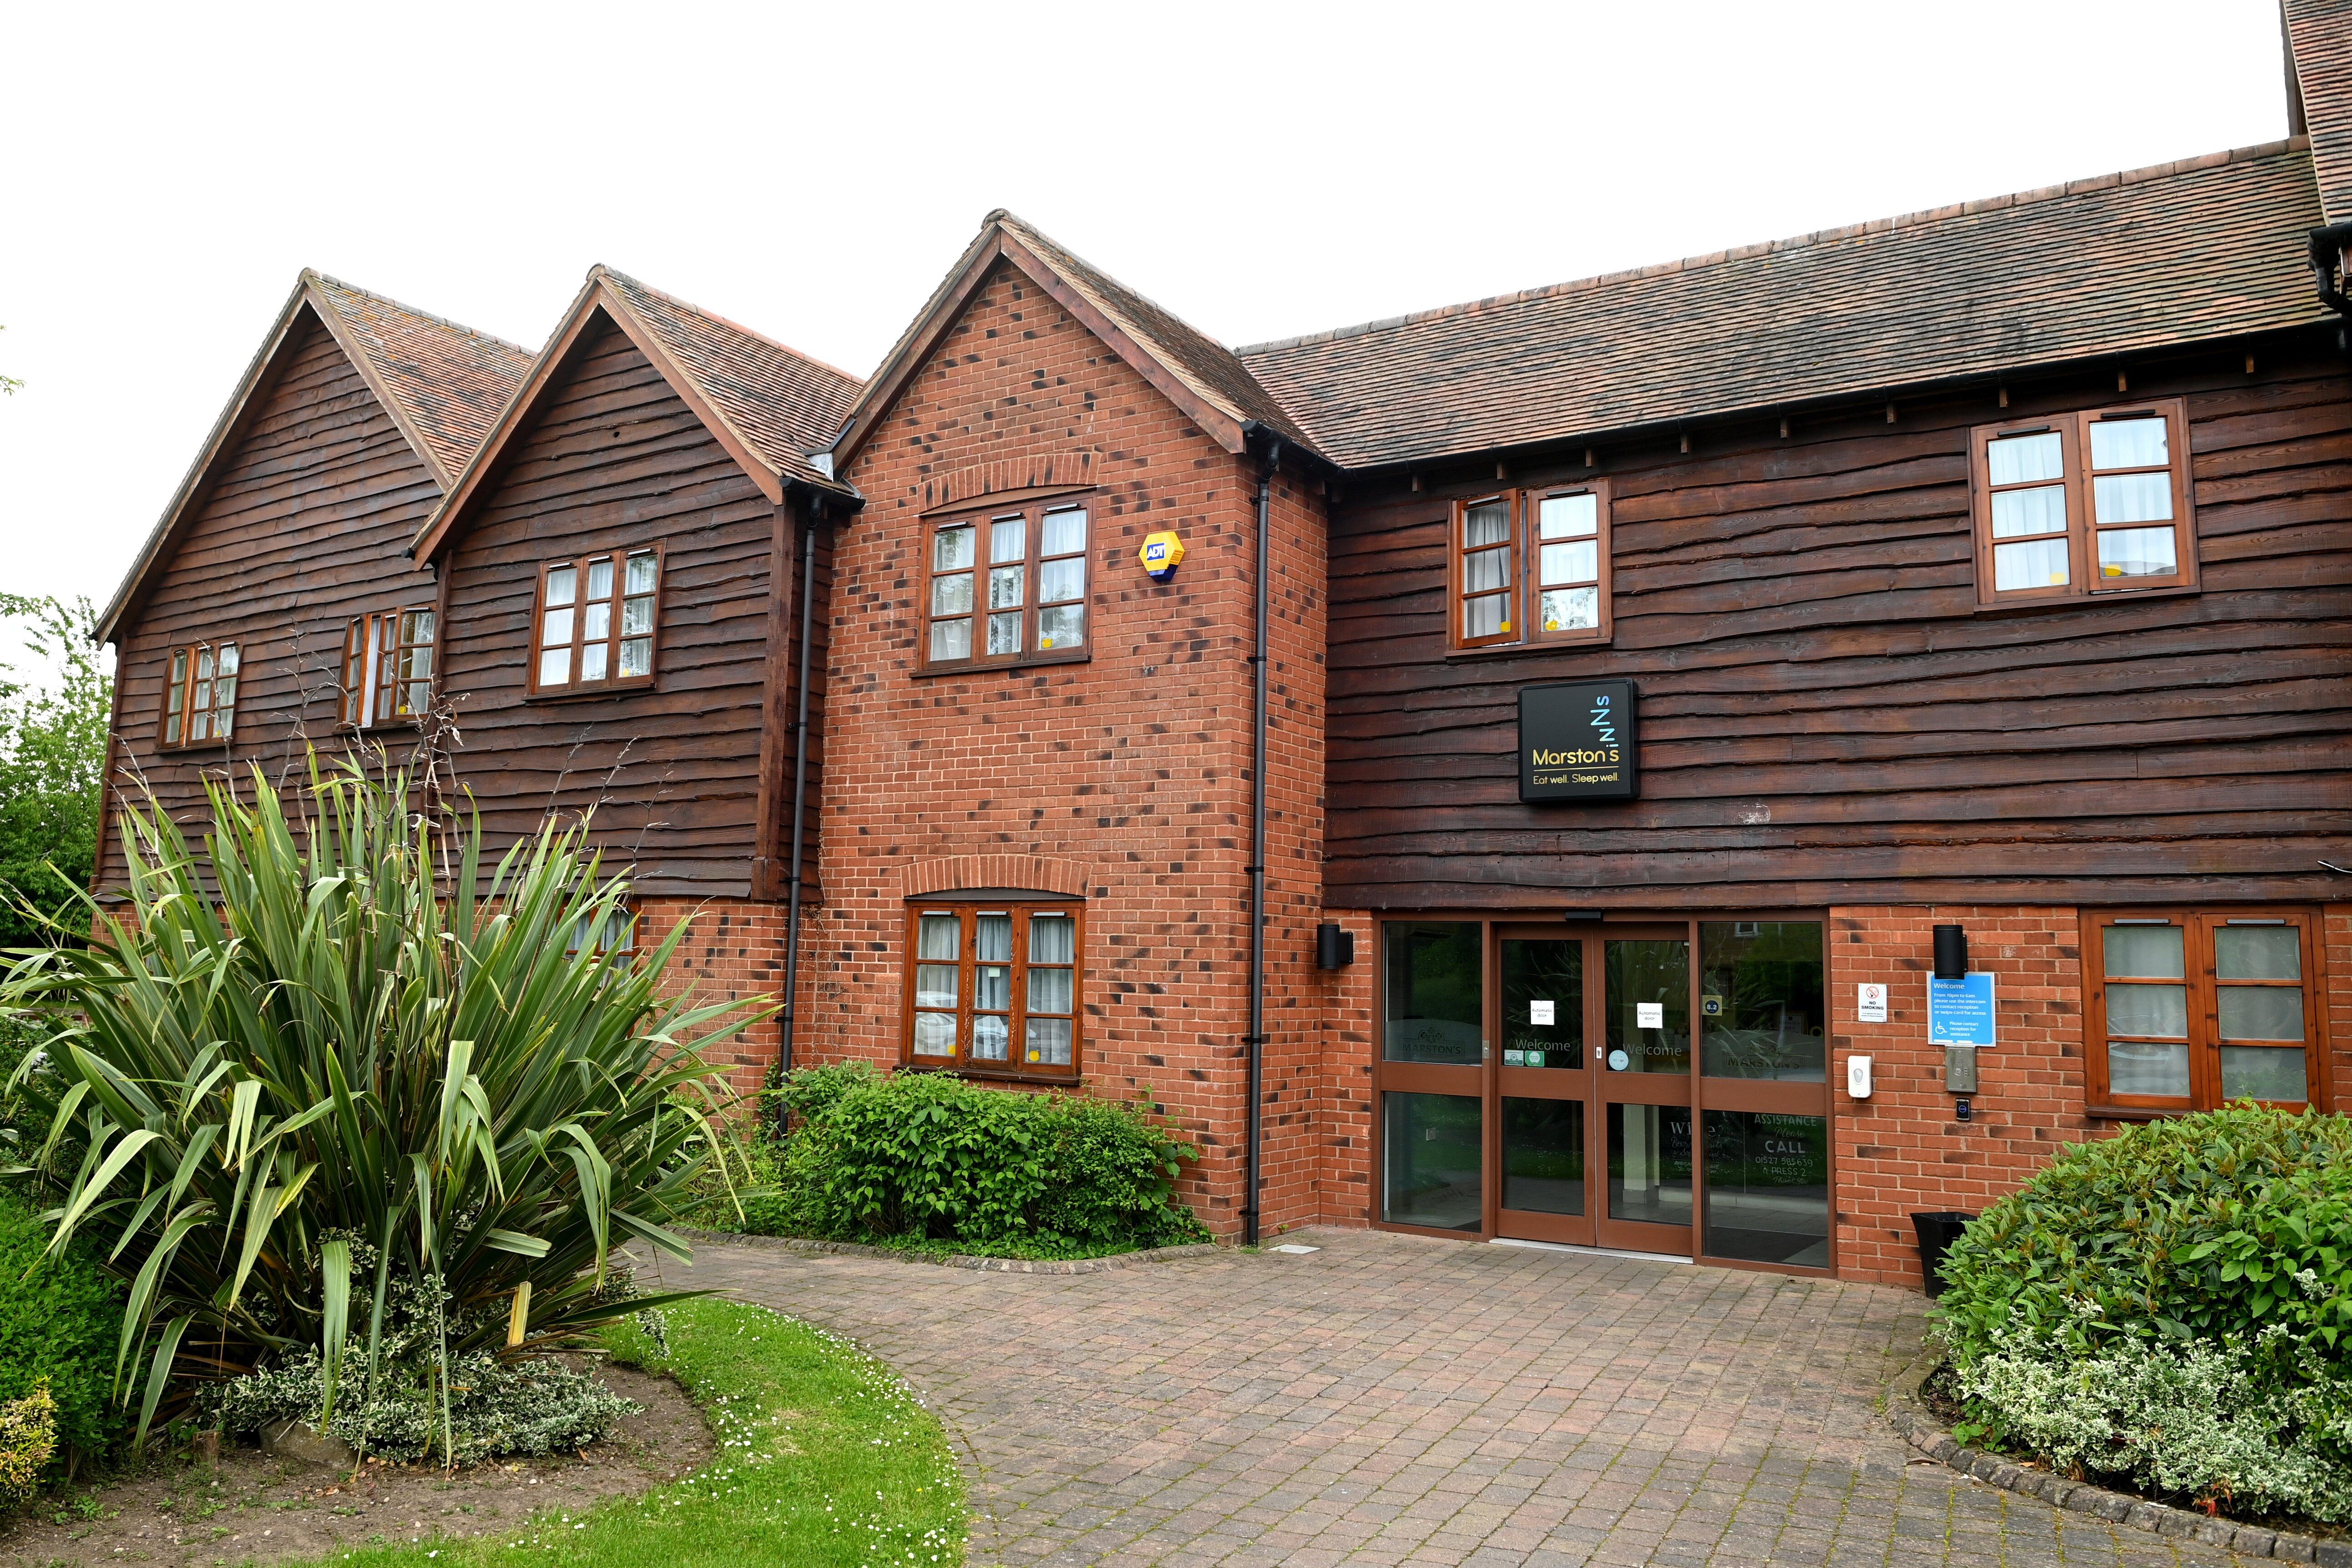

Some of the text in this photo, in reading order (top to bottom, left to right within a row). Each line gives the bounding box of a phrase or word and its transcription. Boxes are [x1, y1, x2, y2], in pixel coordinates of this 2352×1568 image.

[1147, 545, 1164, 558] ADT
[1533, 772, 1619, 784] Eat well. Sleep well.
[1402, 1044, 1461, 1054] MARSTON'S
[1516, 1039, 1571, 1051] Welcome
[1623, 1043, 1682, 1056] Welcome
[1728, 1058, 1800, 1069] MARSONS
[1755, 1114, 1817, 1126] ASSISTANCE
[1775, 1127, 1805, 1138] Please
[1755, 1156, 1778, 1164] 01527
[1771, 1167, 1797, 1175] PRESS
